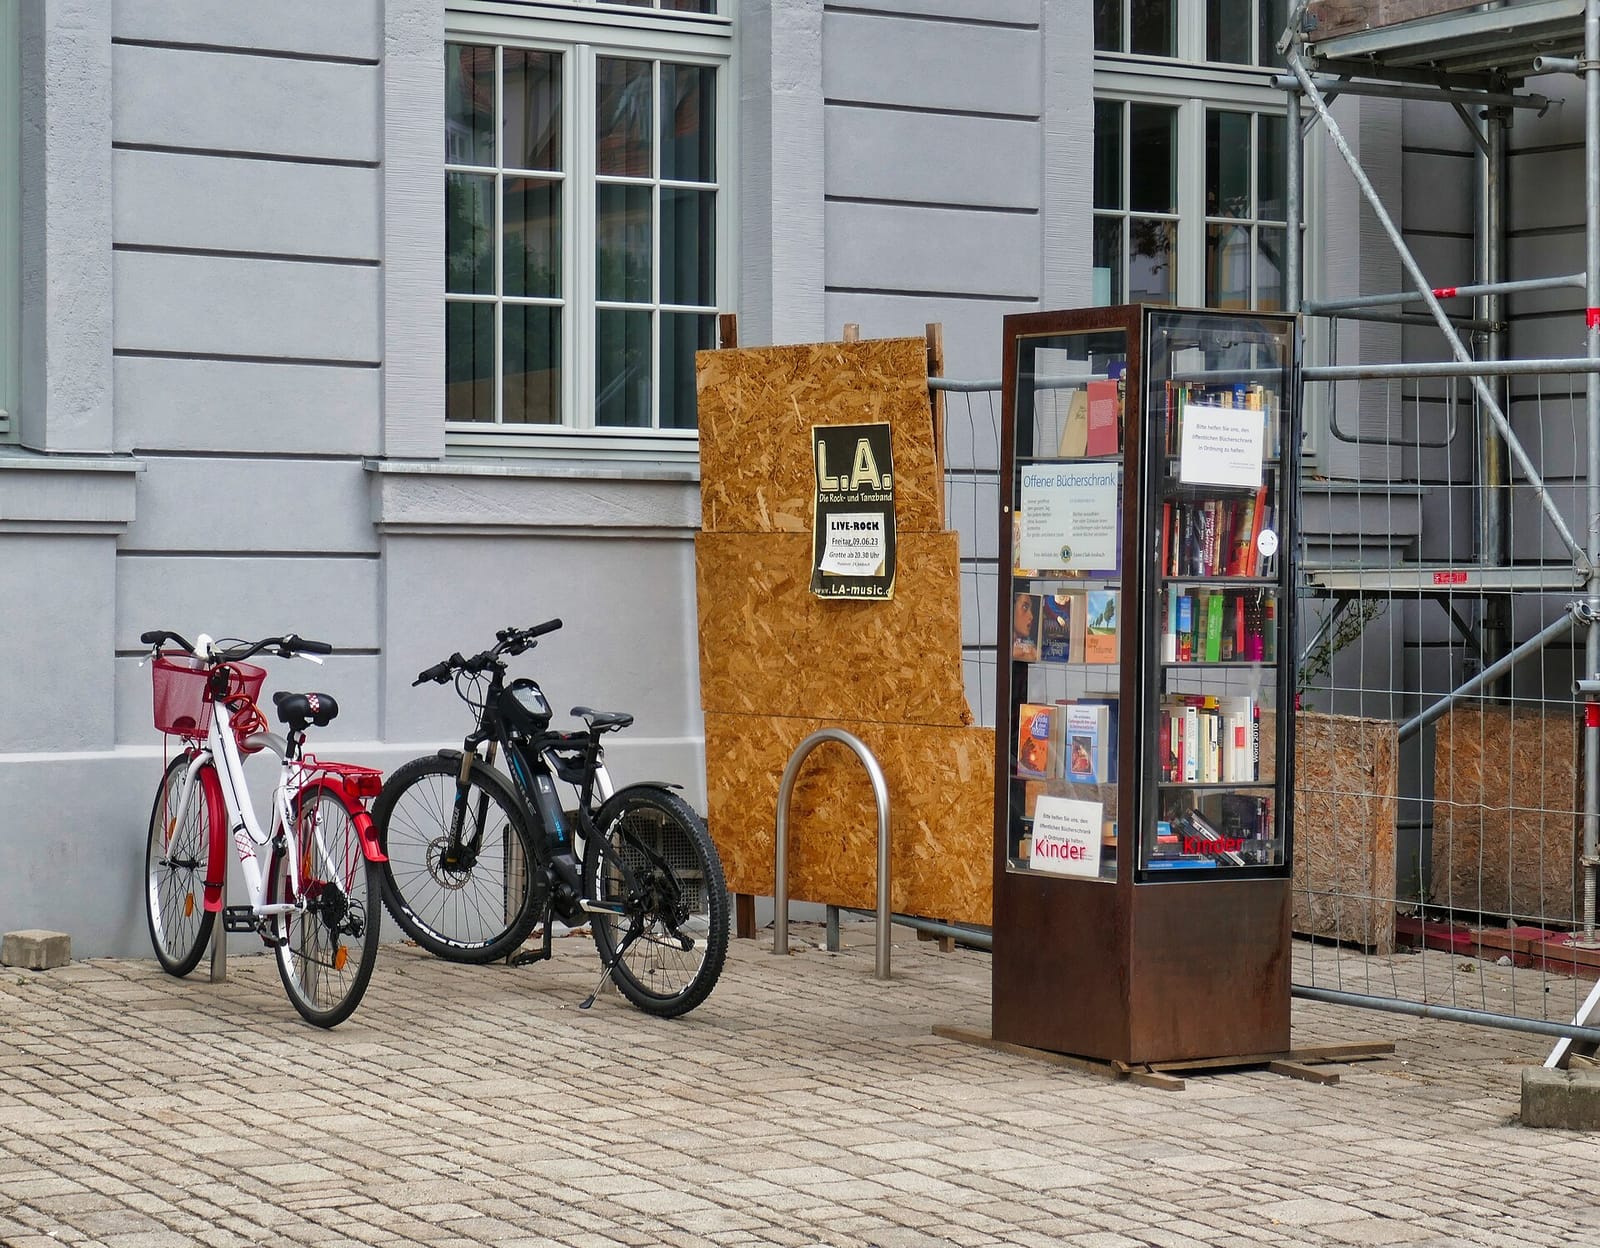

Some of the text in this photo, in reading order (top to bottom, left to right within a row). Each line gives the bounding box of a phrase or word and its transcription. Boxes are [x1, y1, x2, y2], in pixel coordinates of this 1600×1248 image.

[818, 438, 892, 492] L.A.
[1023, 472, 1116, 488] Offener Bücherschrank
[819, 491, 893, 502] Die Rock- und Tanzband
[831, 521, 880, 531] LIVE-ROCK
[829, 550, 880, 559] Grotte ab 20.30 Uhr
[1035, 839, 1086, 860] Kinder
[1183, 834, 1245, 855] Kinder
